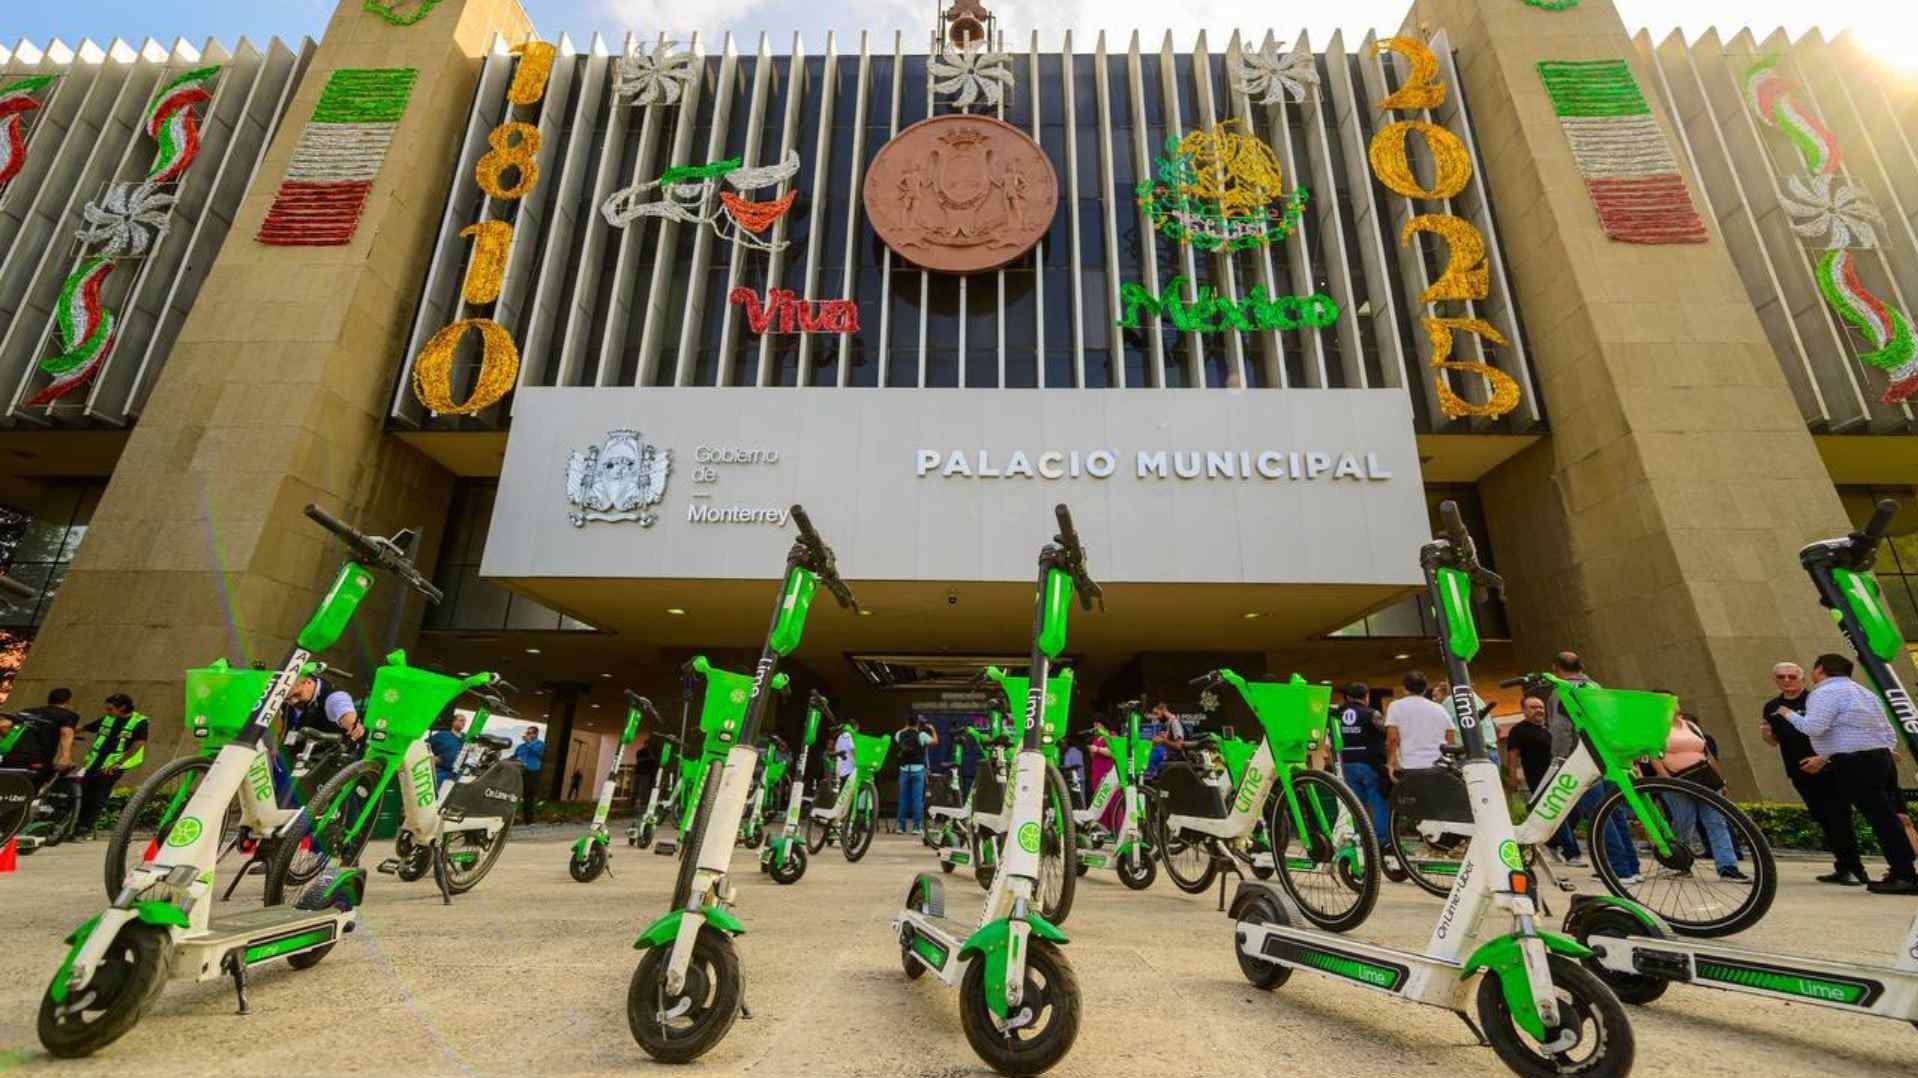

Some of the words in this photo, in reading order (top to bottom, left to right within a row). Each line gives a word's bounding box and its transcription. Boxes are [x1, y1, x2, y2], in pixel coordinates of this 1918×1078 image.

[413, 40, 556, 416] 1810
[1368, 35, 1521, 418] 2025
[730, 286, 860, 335] Viva
[691, 466, 718, 483] de
[694, 446, 780, 465] Gobierno
[916, 449, 1117, 479] PALACIO
[1136, 449, 1394, 481] MUNICIPAL
[688, 503, 791, 528] Monterrey
[1024, 687, 1041, 730] Lime
[1453, 684, 1476, 729] Lime
[1885, 688, 1918, 734] Lime
[410, 755, 435, 807] Lime
[1235, 766, 1263, 814] Lime
[1534, 773, 1578, 822] Lime
[1358, 963, 1387, 985] Lime
[1799, 978, 1845, 1001] Lime
